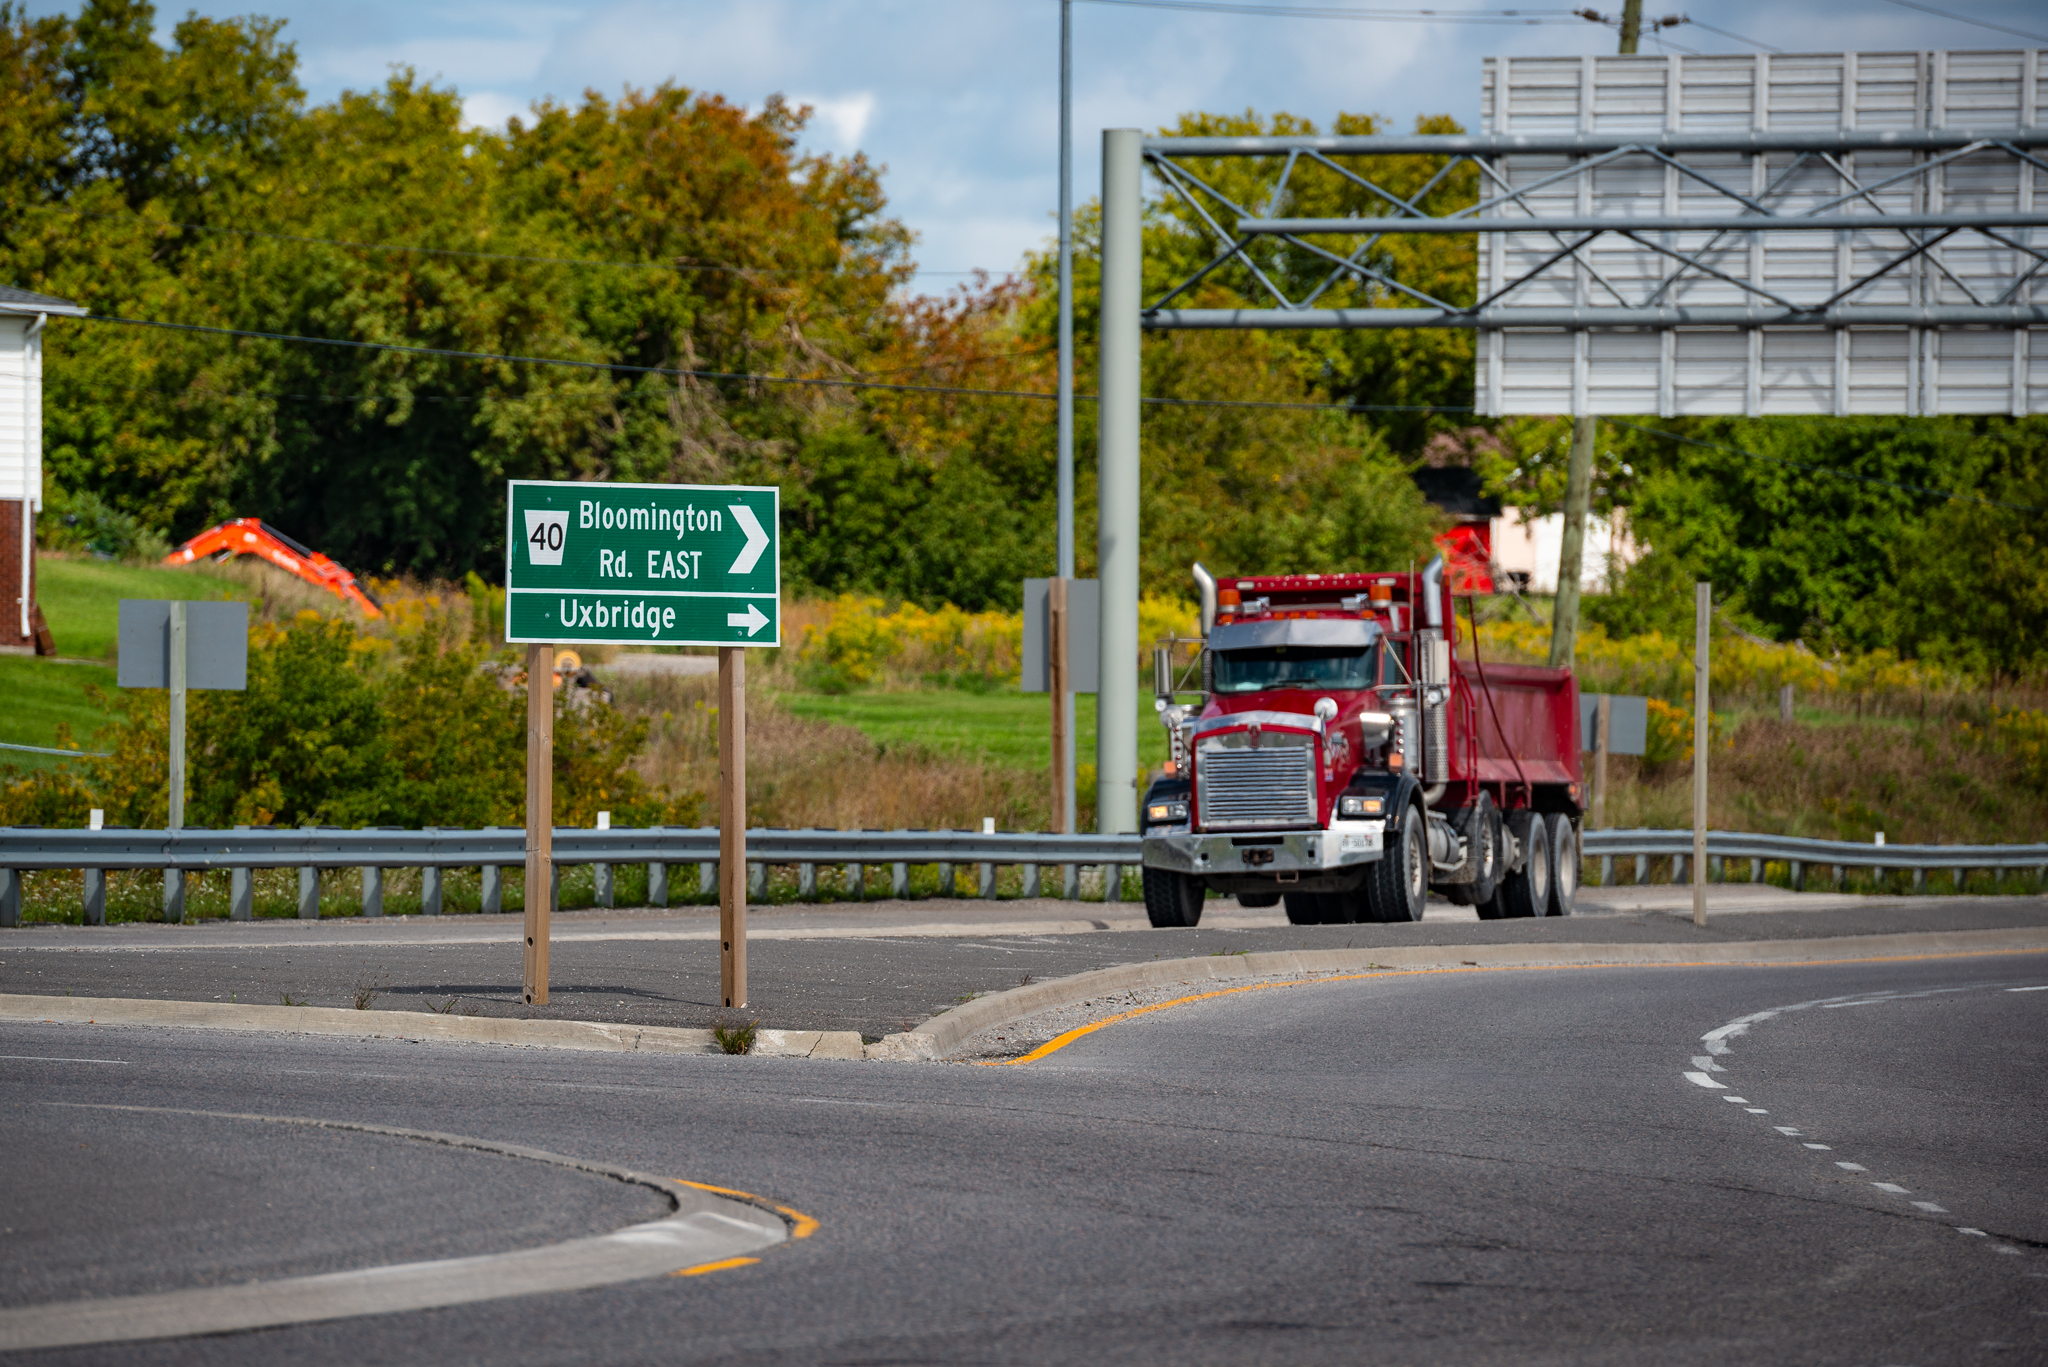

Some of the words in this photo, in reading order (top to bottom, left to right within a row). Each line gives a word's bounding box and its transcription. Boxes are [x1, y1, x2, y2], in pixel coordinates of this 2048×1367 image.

[530, 522, 563, 551] 40
[580, 500, 722, 541] Bloomington
[600, 549, 633, 578] Rd.
[648, 550, 702, 579] EAST
[560, 598, 676, 638] Uxbridge
